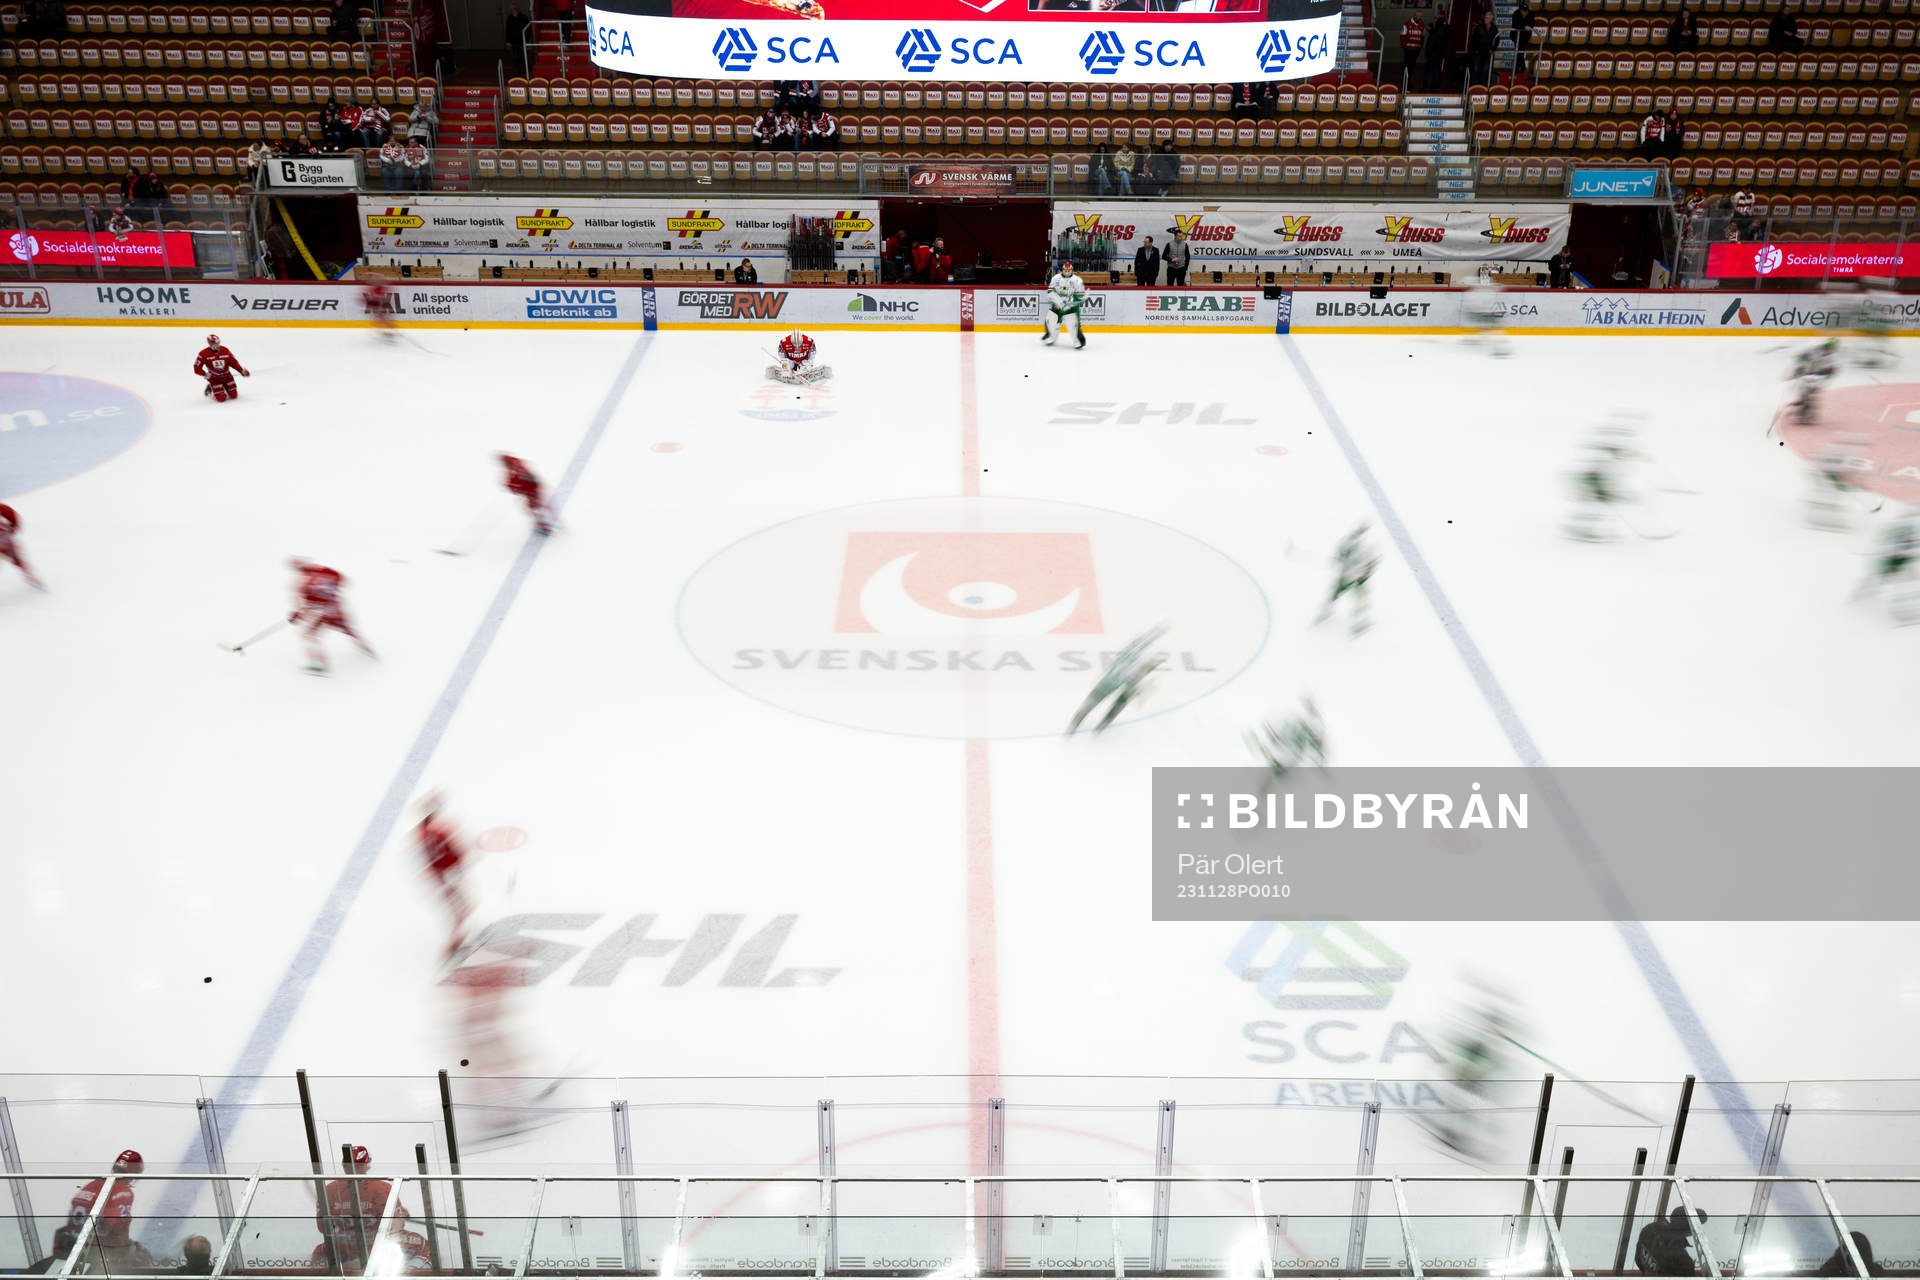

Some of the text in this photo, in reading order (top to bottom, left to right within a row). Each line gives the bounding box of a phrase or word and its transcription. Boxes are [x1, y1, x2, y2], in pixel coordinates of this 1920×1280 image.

[600, 26, 635, 57] SCA
[767, 37, 840, 64] SCA
[950, 37, 1023, 65] SCA
[1134, 40, 1206, 67] SCA
[1296, 34, 1328, 63] SCA
[298, 164, 323, 175] Bygg
[300, 174, 344, 185] Giganten
[942, 173, 978, 181] SVENSK
[1574, 181, 1643, 193] JUNET
[433, 217, 505, 228] Hållbar logistik
[520, 219, 565, 227] SUNDFRAKT
[585, 218, 656, 229] Hållbar logistik
[671, 221, 716, 229] SUNDFRAKT
[736, 220, 769, 229] Hållbar
[43, 240, 164, 255] Socialdemokraterna
[454, 239, 489, 247] Solventum
[627, 240, 662, 248] Solventum
[1193, 246, 1423, 257] STOCKHOLM SUNDSVALL UMEÅ
[97, 286, 191, 303] HOOME
[412, 293, 469, 305] All sports
[526, 289, 617, 305] JOWIC
[682, 292, 734, 304] GÖR DET
[733, 291, 789, 318] RW
[879, 301, 920, 312] NHC
[1158, 295, 1243, 311] PEAB
[119, 306, 176, 316] MÄKLERI
[413, 305, 451, 315] united
[532, 307, 612, 317] elteknik ab
[704, 306, 732, 317] MED
[1316, 302, 1430, 317] BILBOLAGET
[1510, 305, 1538, 316] SCA
[1145, 313, 1254, 322] NORDENS SAMHÄLLSBYGGARE
[1592, 310, 1706, 326] AB KARL HEDIN
[1761, 307, 1840, 326] Adven
[1048, 401, 1258, 425] SHL
[732, 648, 1038, 672] SVENSKA
[436, 913, 843, 988] SHL
[1241, 1020, 1450, 1065] SCA
[1274, 1081, 1447, 1106] ARENA
